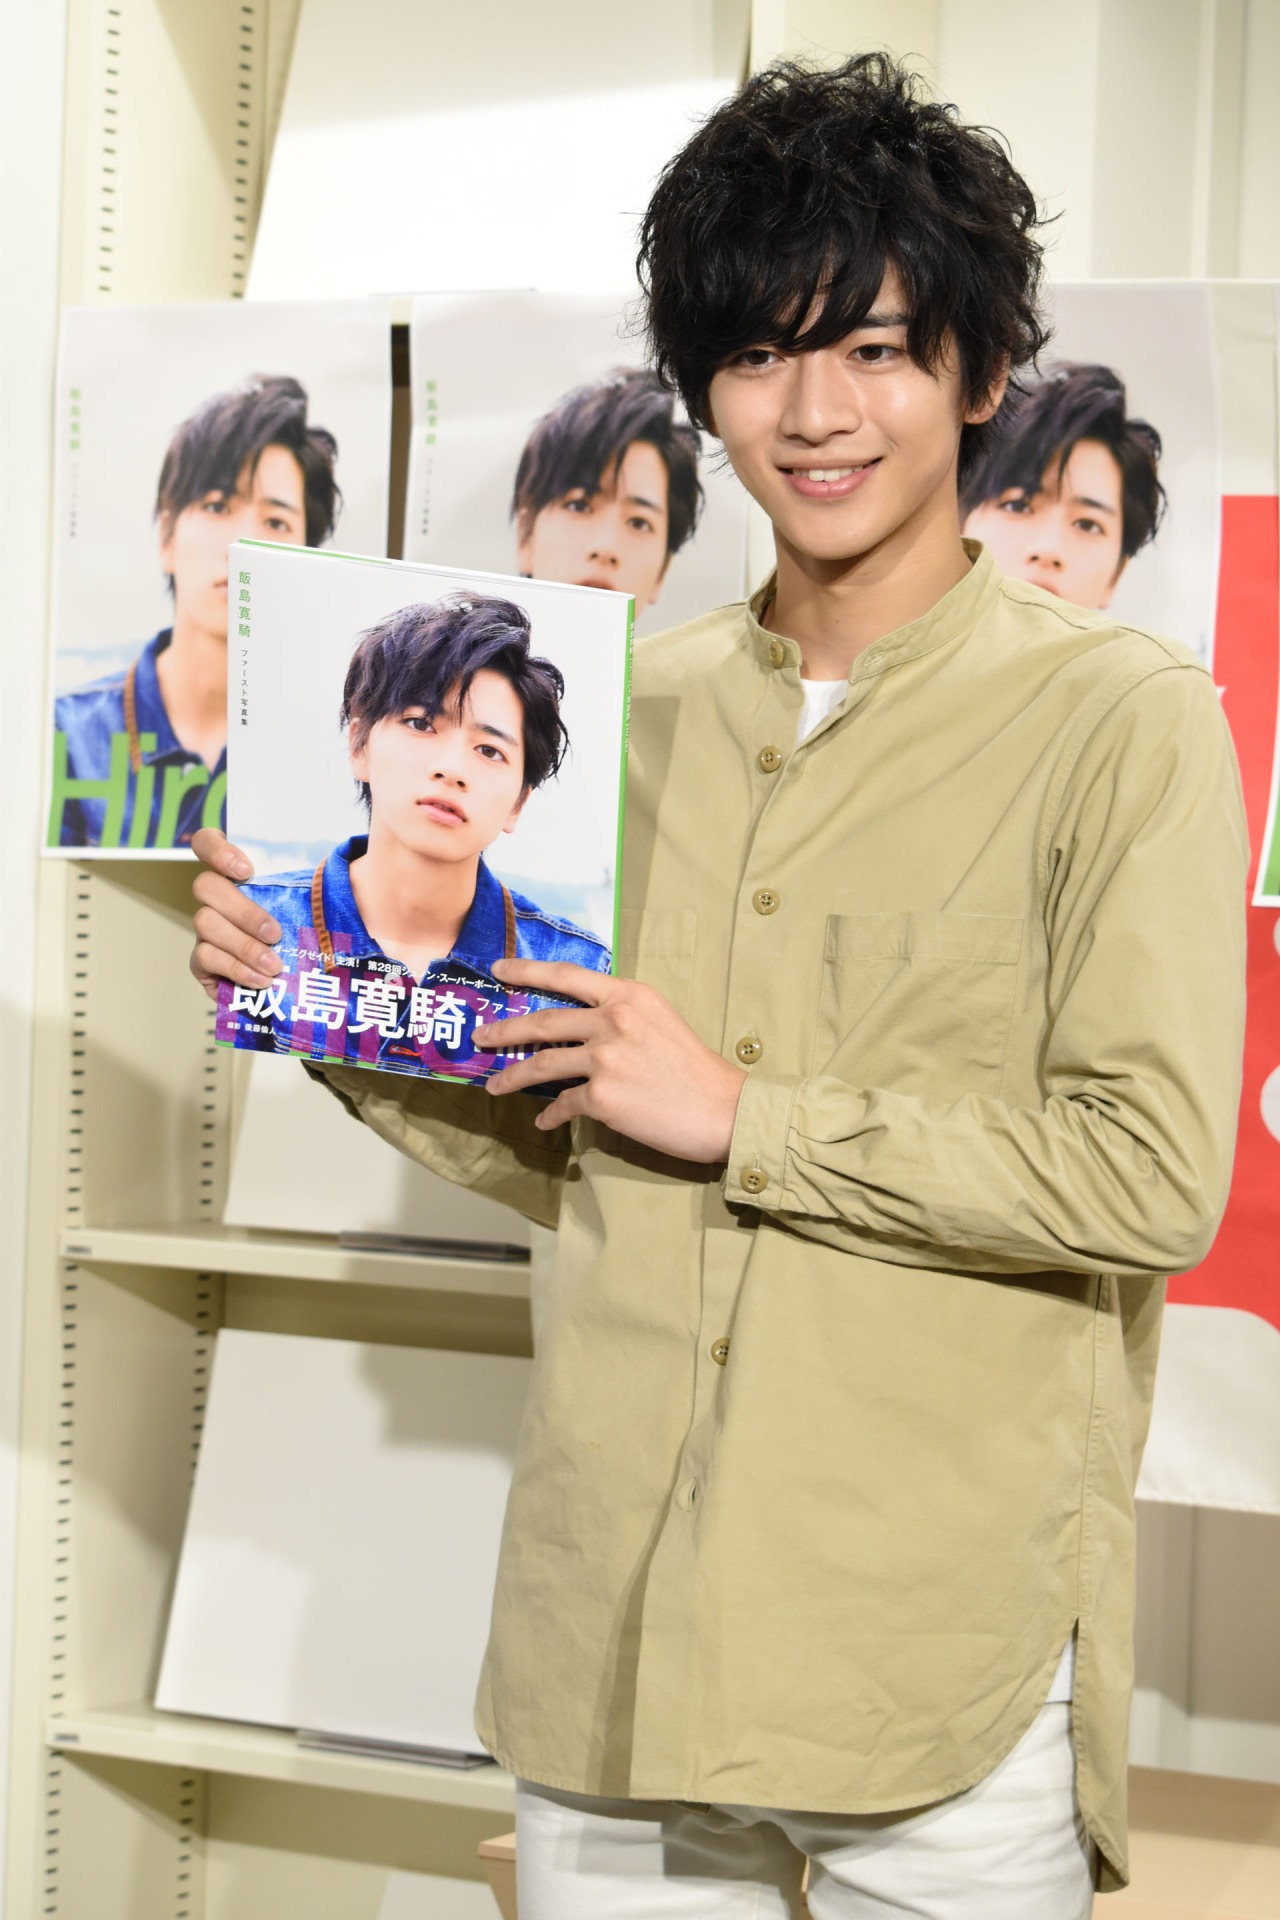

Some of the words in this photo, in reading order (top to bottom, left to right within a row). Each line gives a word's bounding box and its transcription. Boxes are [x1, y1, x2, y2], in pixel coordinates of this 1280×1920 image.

[238, 571, 251, 638] 飯島寛騎
[240, 649, 249, 727] ファースト写真集
